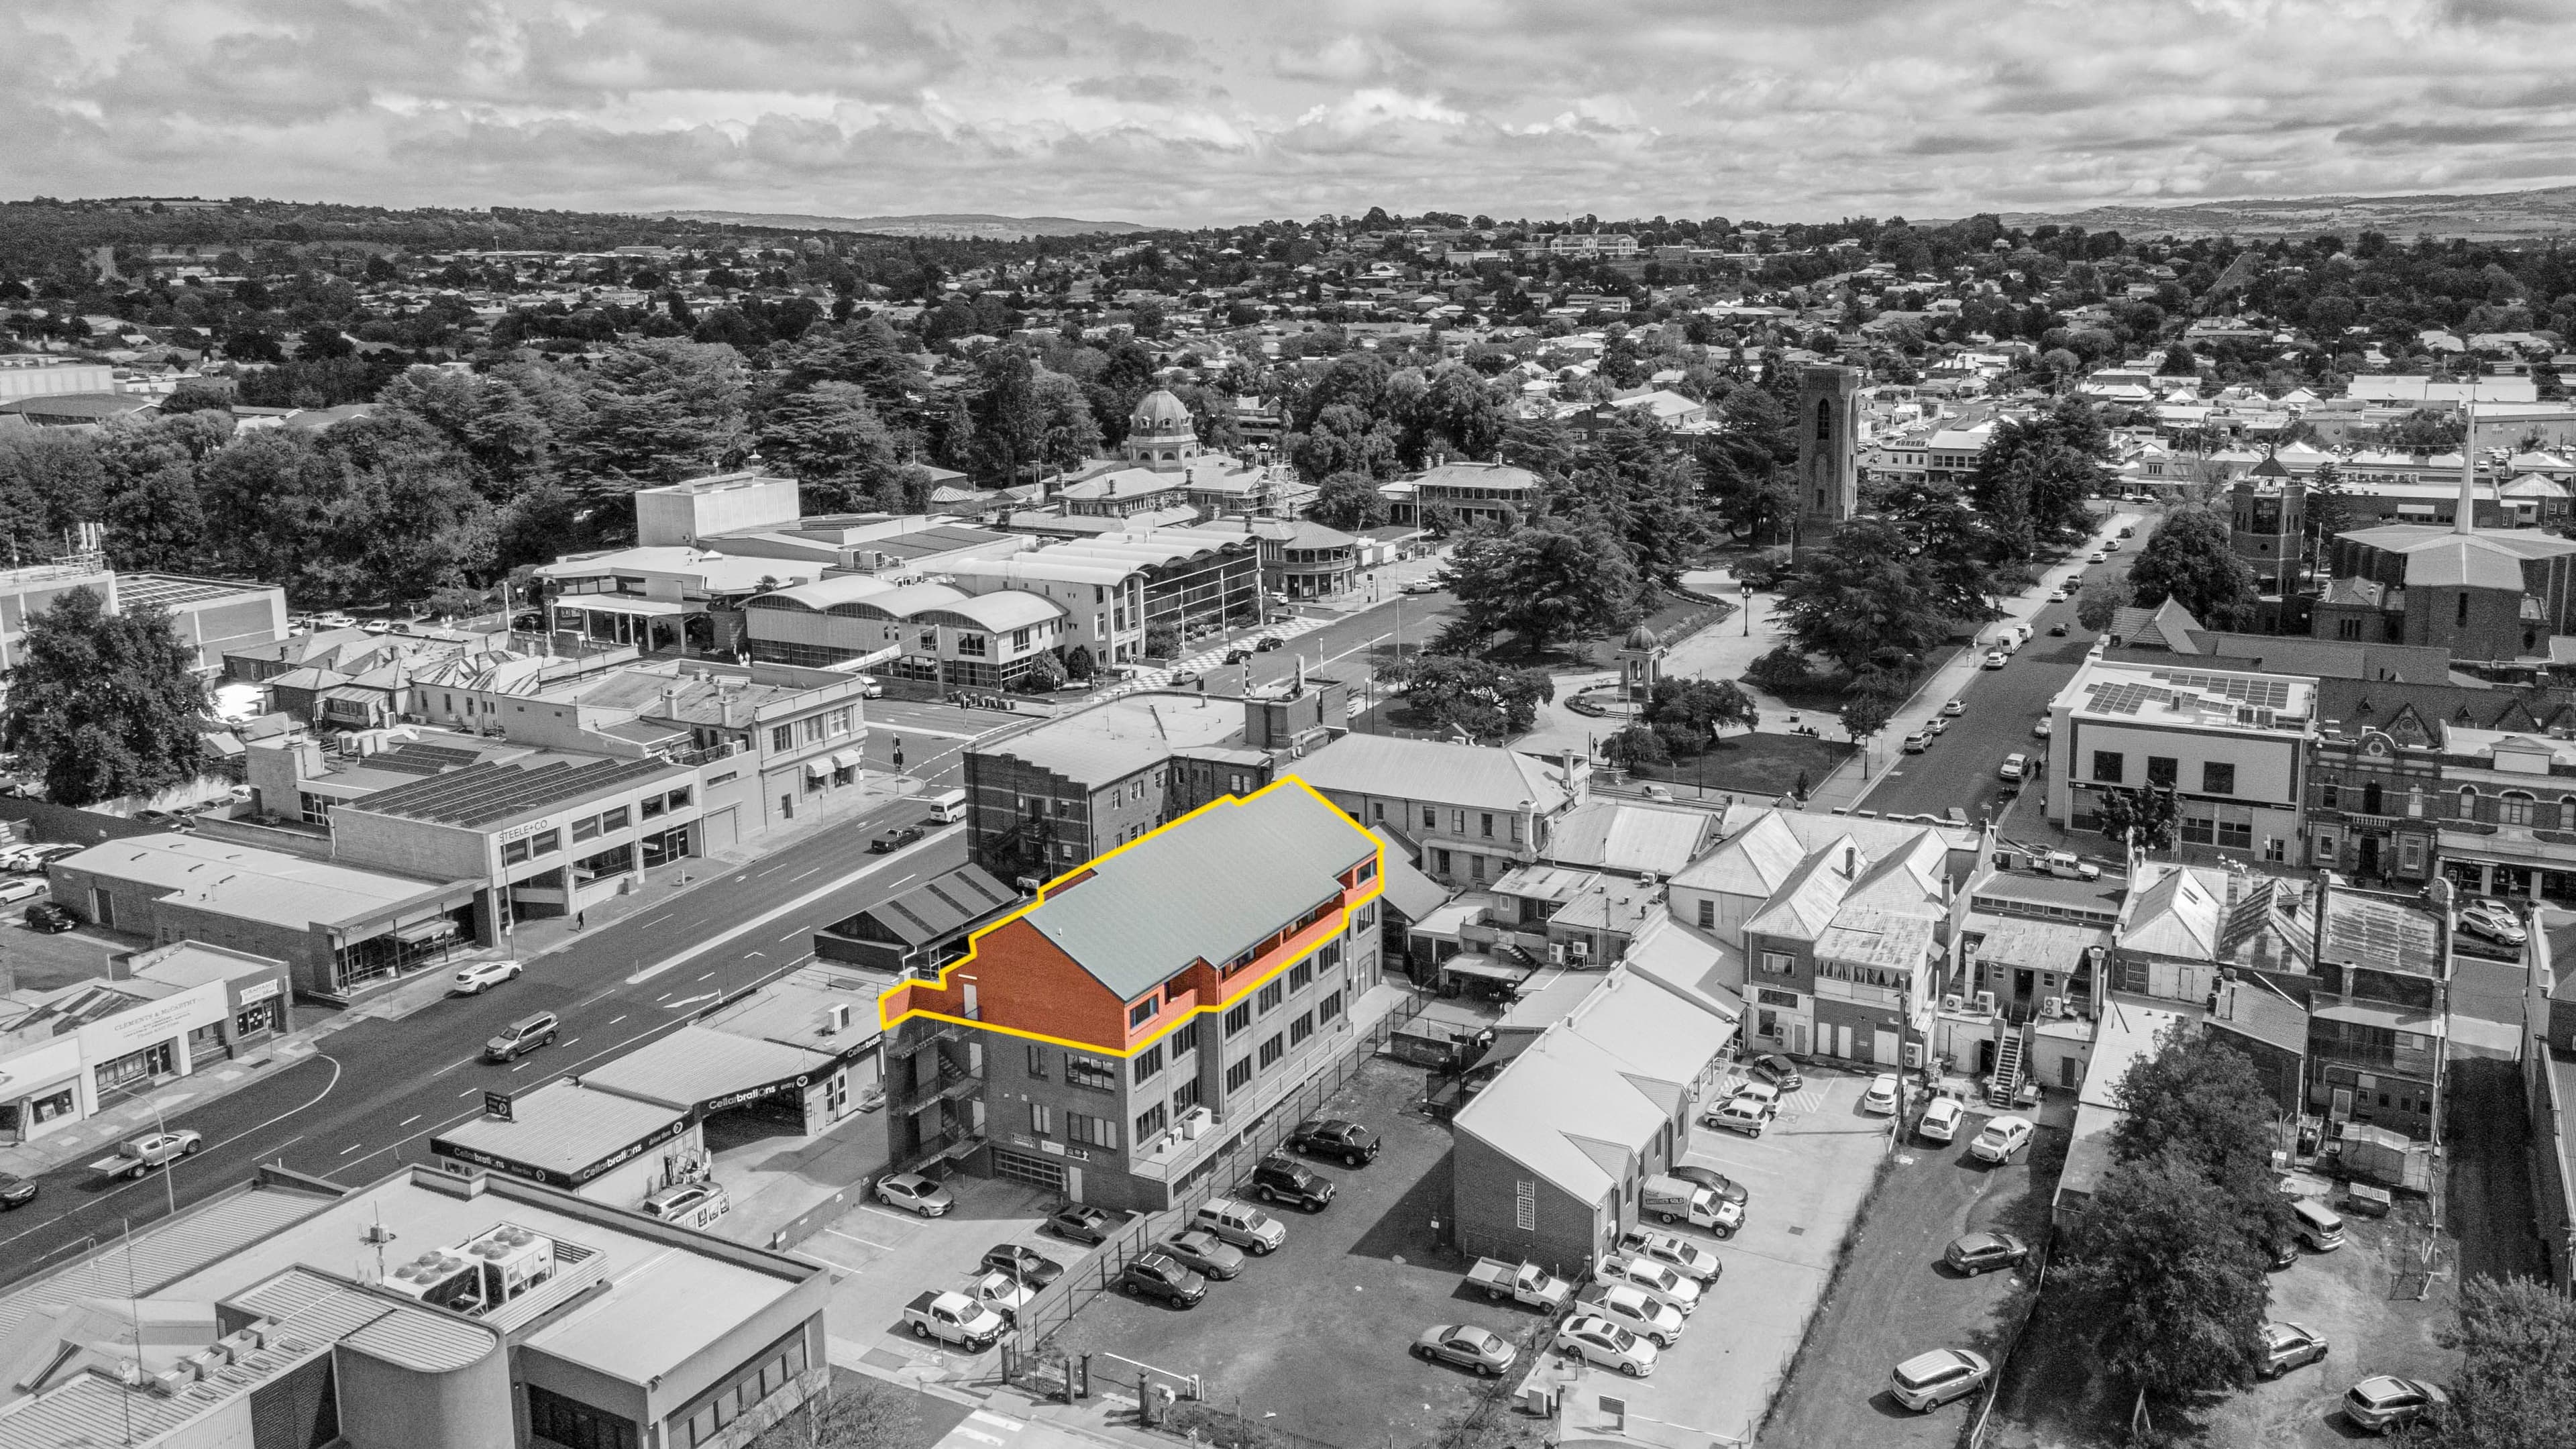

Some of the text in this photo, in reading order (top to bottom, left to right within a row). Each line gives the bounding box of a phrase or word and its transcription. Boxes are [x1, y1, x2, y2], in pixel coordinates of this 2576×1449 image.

[498, 820, 548, 843] STEELE+CO
[708, 1085, 776, 1110] Cellarbrations
[454, 1148, 504, 1169] Cellarbrations
[583, 1144, 642, 1179] Cellarbrations
